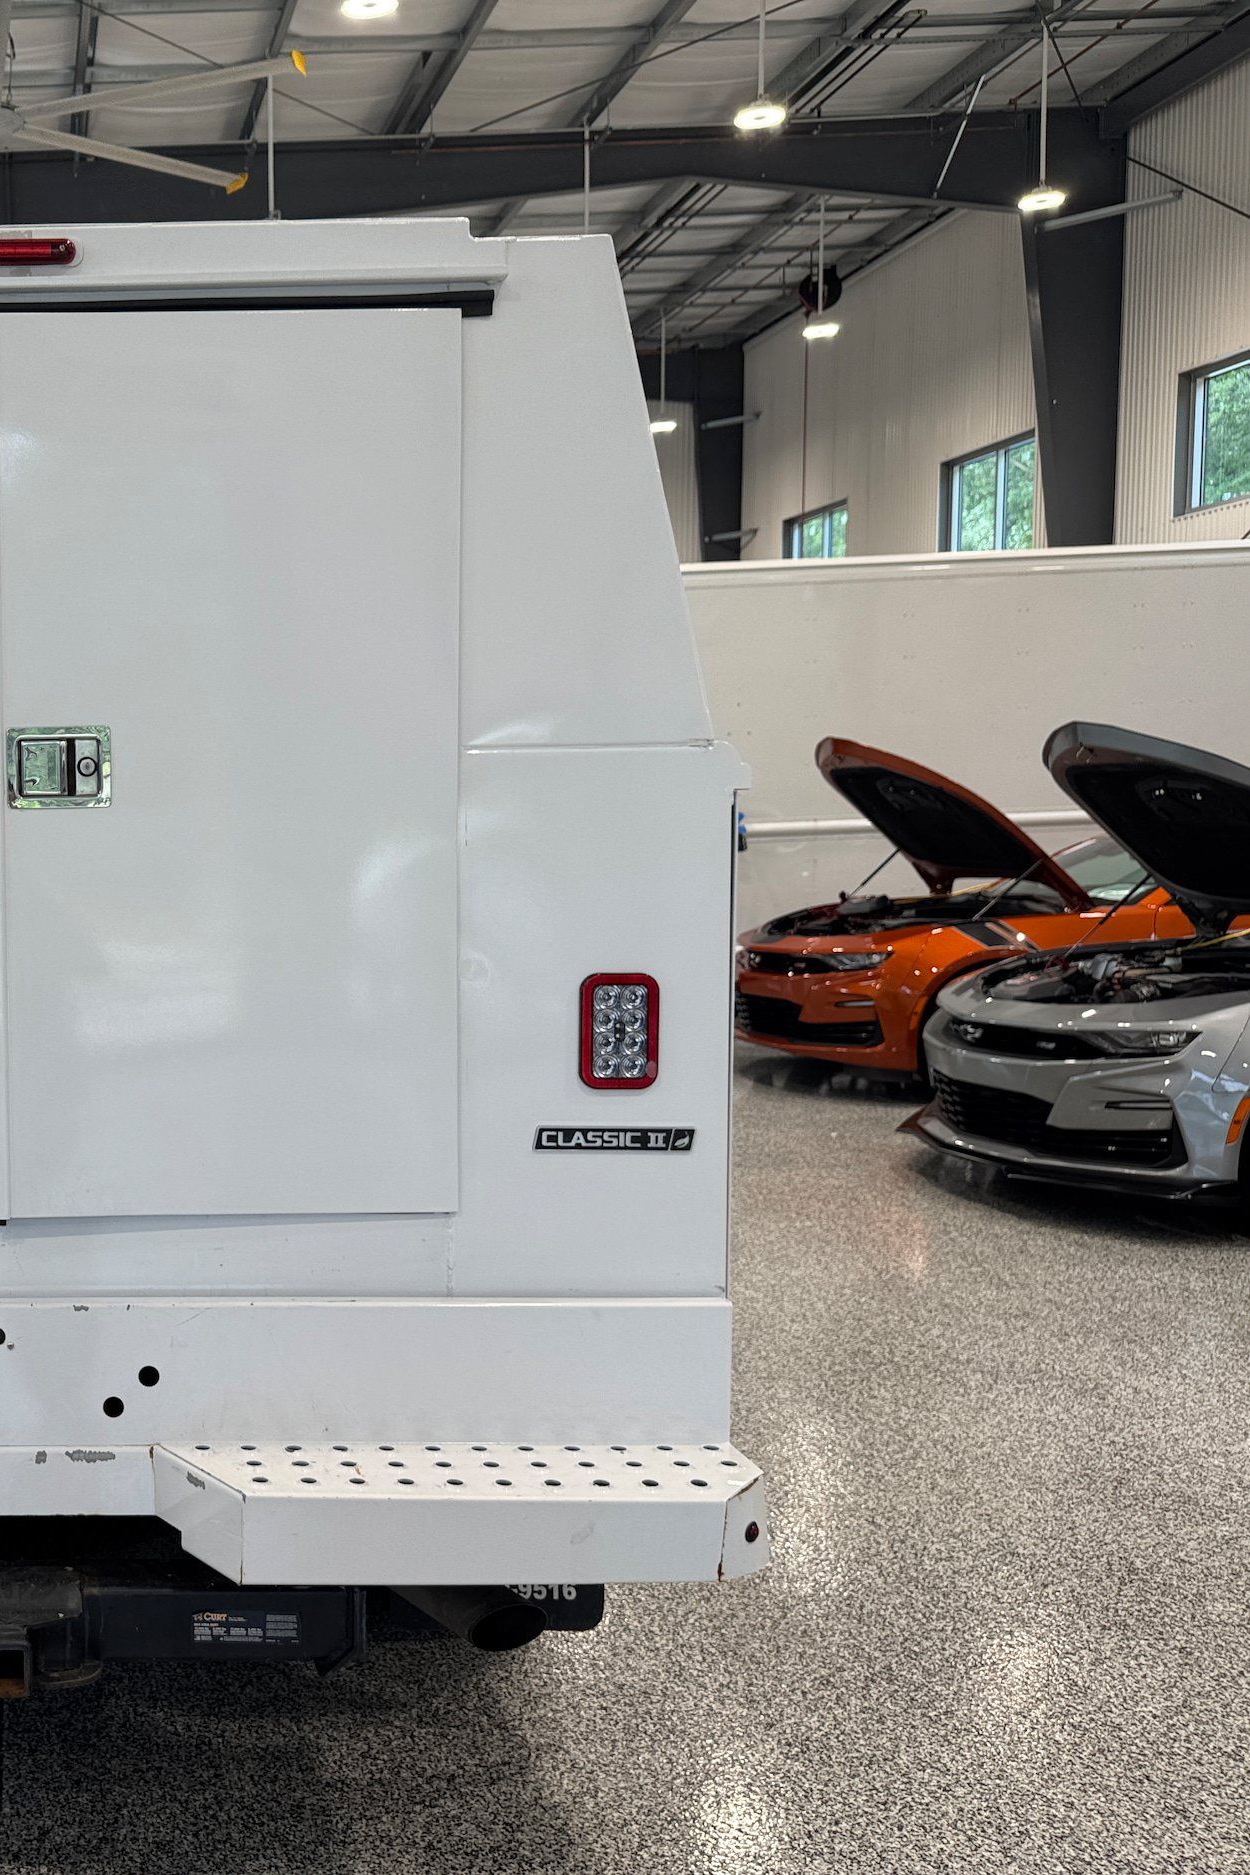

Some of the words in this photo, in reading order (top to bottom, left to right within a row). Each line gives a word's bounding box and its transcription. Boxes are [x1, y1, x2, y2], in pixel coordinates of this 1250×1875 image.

[541, 1131, 641, 1147] CLASSIC
[647, 1133, 666, 1147] II
[504, 1584, 577, 1600] -9516
